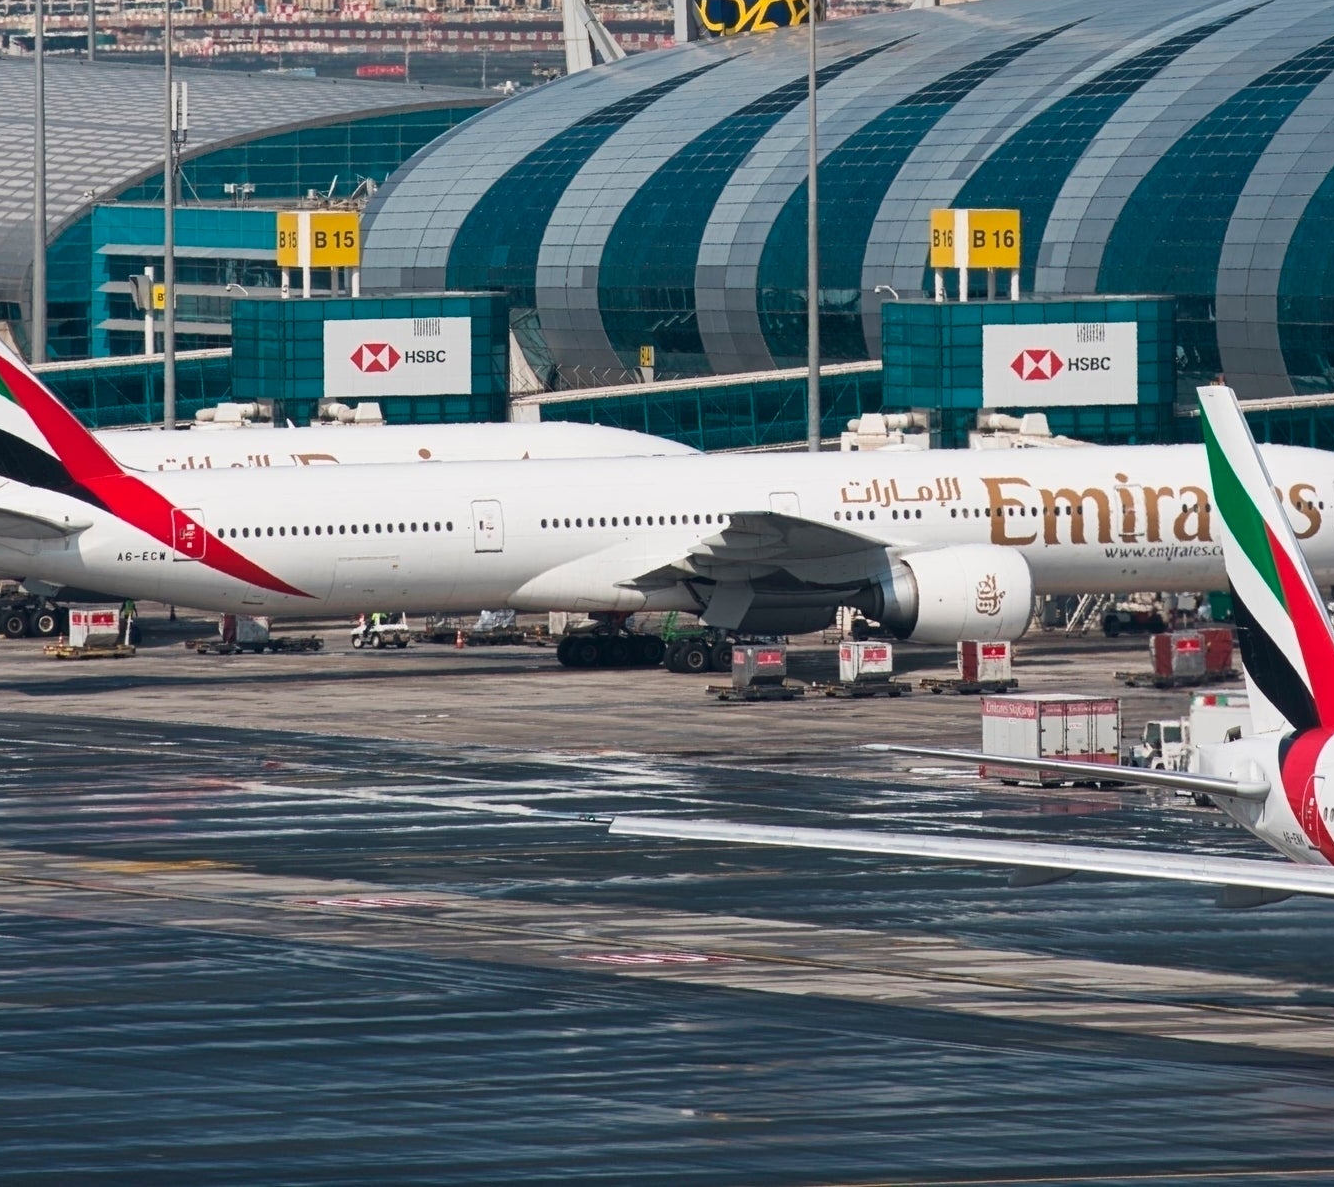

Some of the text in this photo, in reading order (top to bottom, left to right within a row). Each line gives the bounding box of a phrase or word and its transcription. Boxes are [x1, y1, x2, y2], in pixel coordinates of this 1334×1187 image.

[315, 232, 355, 249] B 15
[933, 229, 953, 247] B 16
[973, 229, 1015, 247] B 16
[405, 351, 447, 363] HSBC
[1068, 357, 1111, 371] HSBC
[841, 477, 962, 507] الإمارات
[981, 473, 1321, 546] Emiras
[117, 551, 166, 561] A6-ECW
